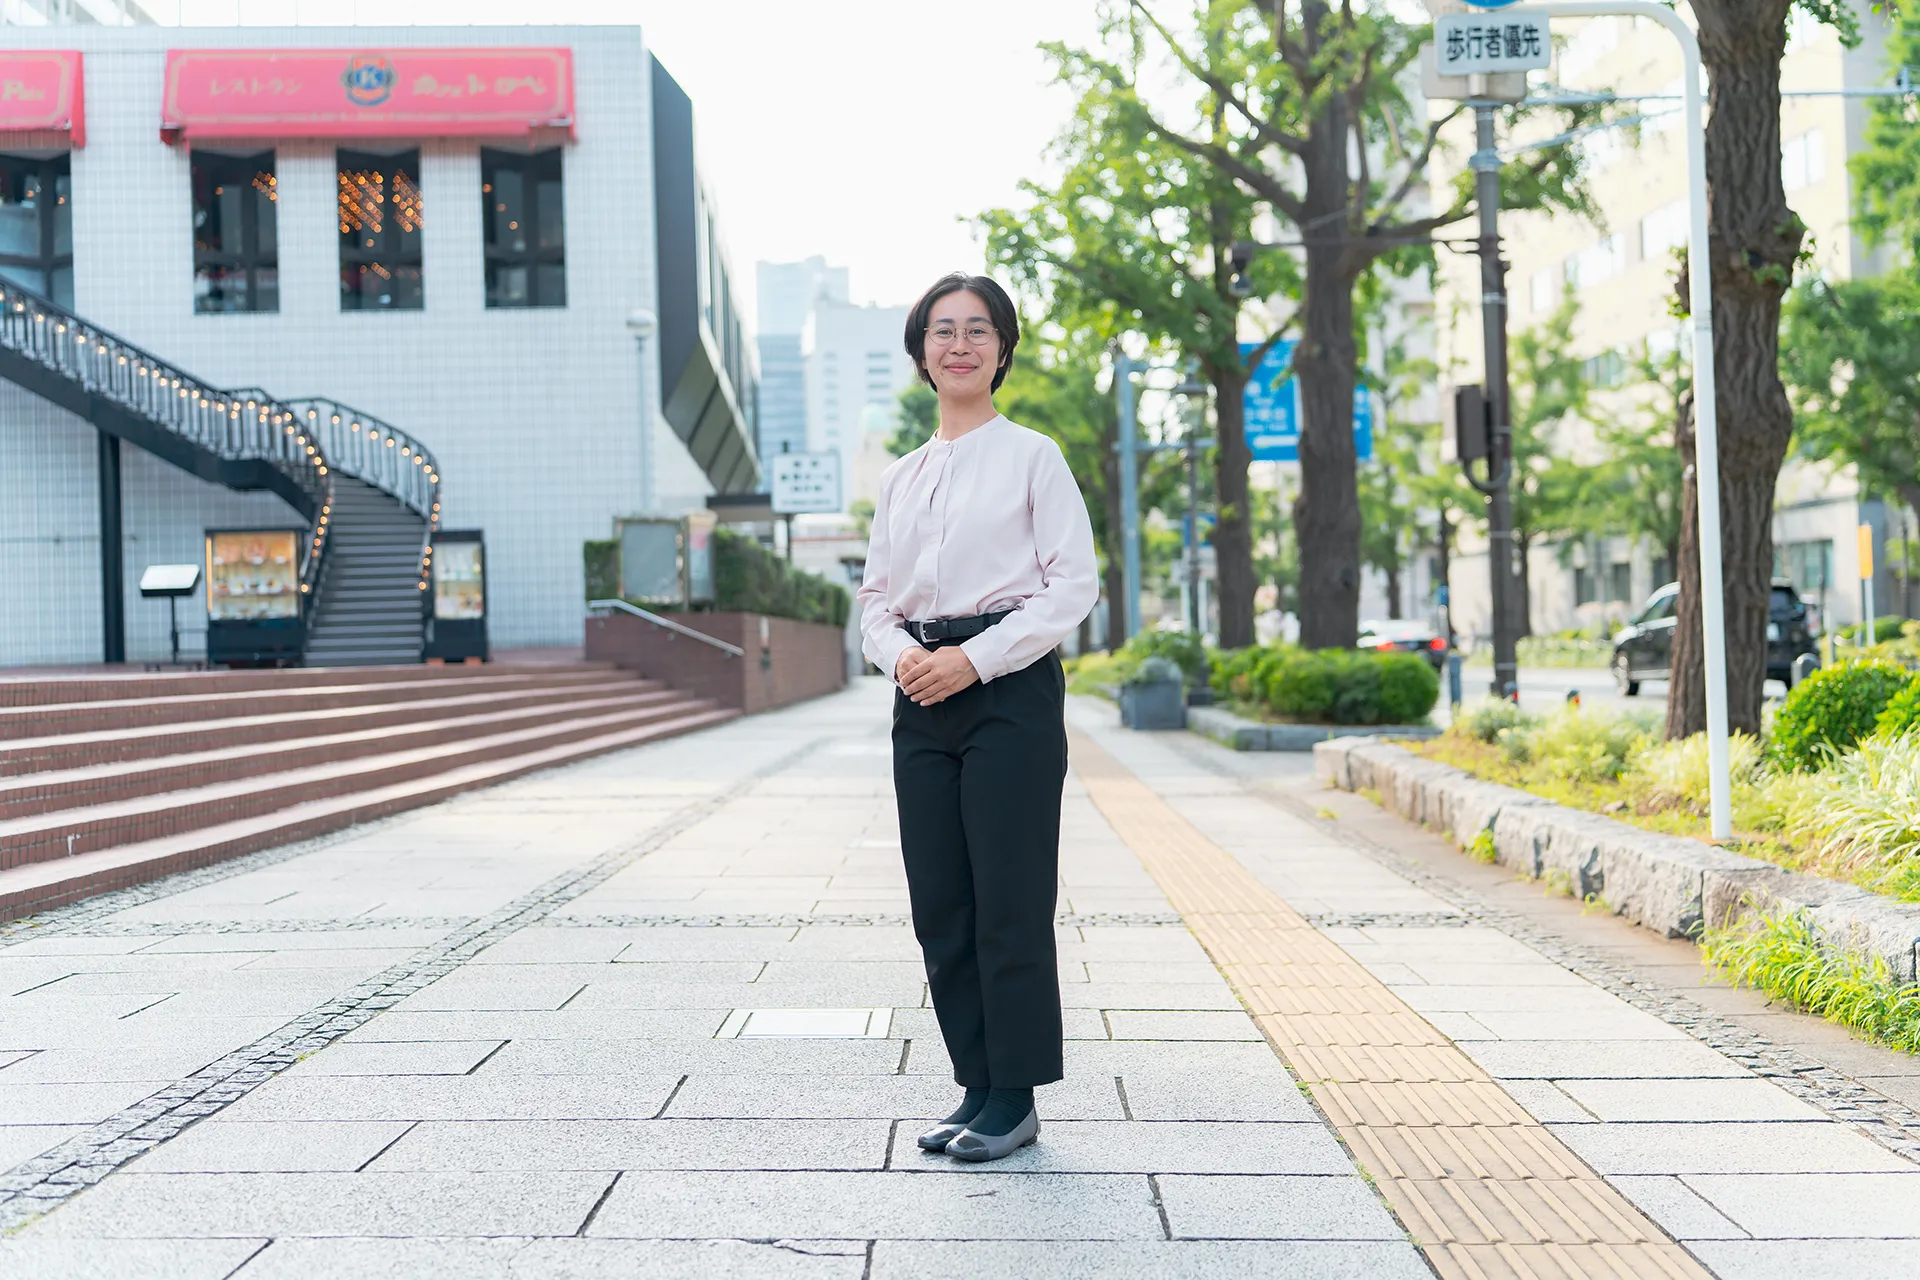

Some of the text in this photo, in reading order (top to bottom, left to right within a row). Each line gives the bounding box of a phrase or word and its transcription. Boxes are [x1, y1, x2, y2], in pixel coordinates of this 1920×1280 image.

[1446, 23, 1542, 63] 歩行者優先
[209, 76, 304, 97] レストラン
